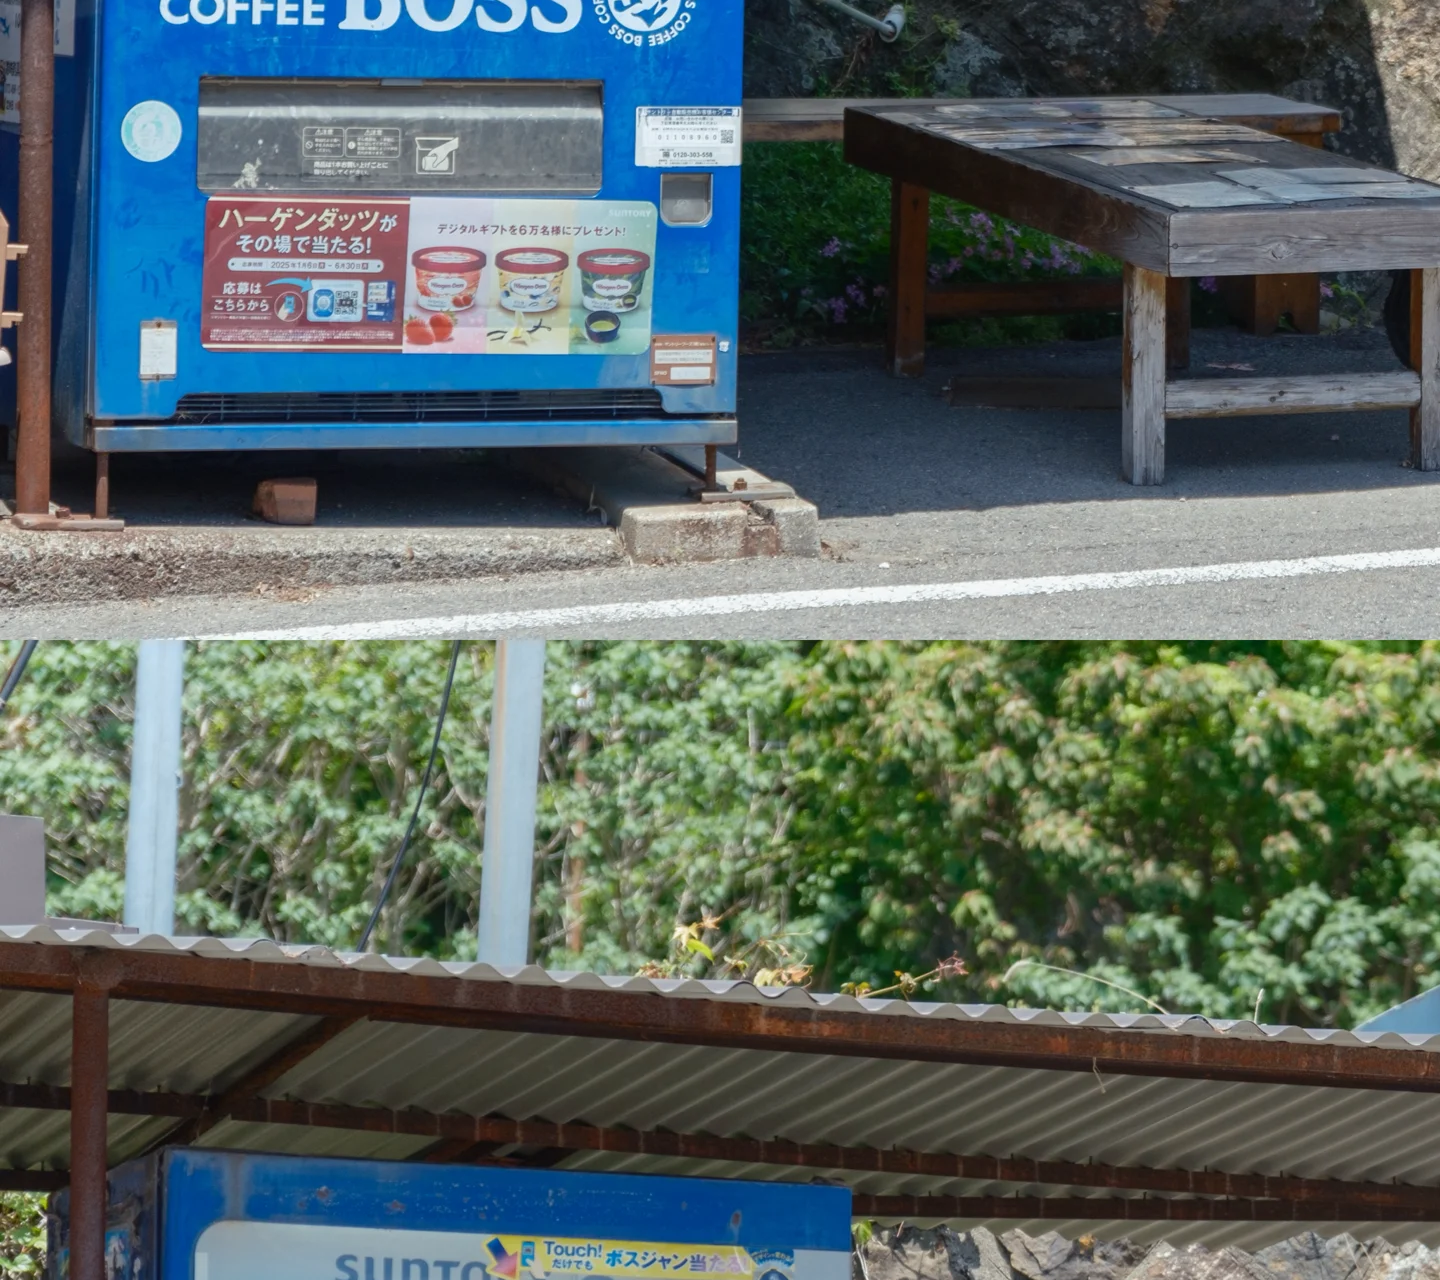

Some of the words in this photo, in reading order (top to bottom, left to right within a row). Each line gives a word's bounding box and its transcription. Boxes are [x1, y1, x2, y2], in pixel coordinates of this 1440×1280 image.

[218, 206, 398, 233] ハーゲンダッツが
[608, 209, 652, 218] SUNTORY
[436, 223, 626, 238] デジタルギフトを6万名様にプレゼント!
[235, 234, 372, 255] その場で当たる!
[222, 282, 262, 295] 応募は
[212, 298, 270, 312] こちらから
[543, 1240, 603, 1258] Touch!
[552, 1259, 593, 1270] だけでも
[605, 1250, 746, 1274] ボスジャン当たる!
